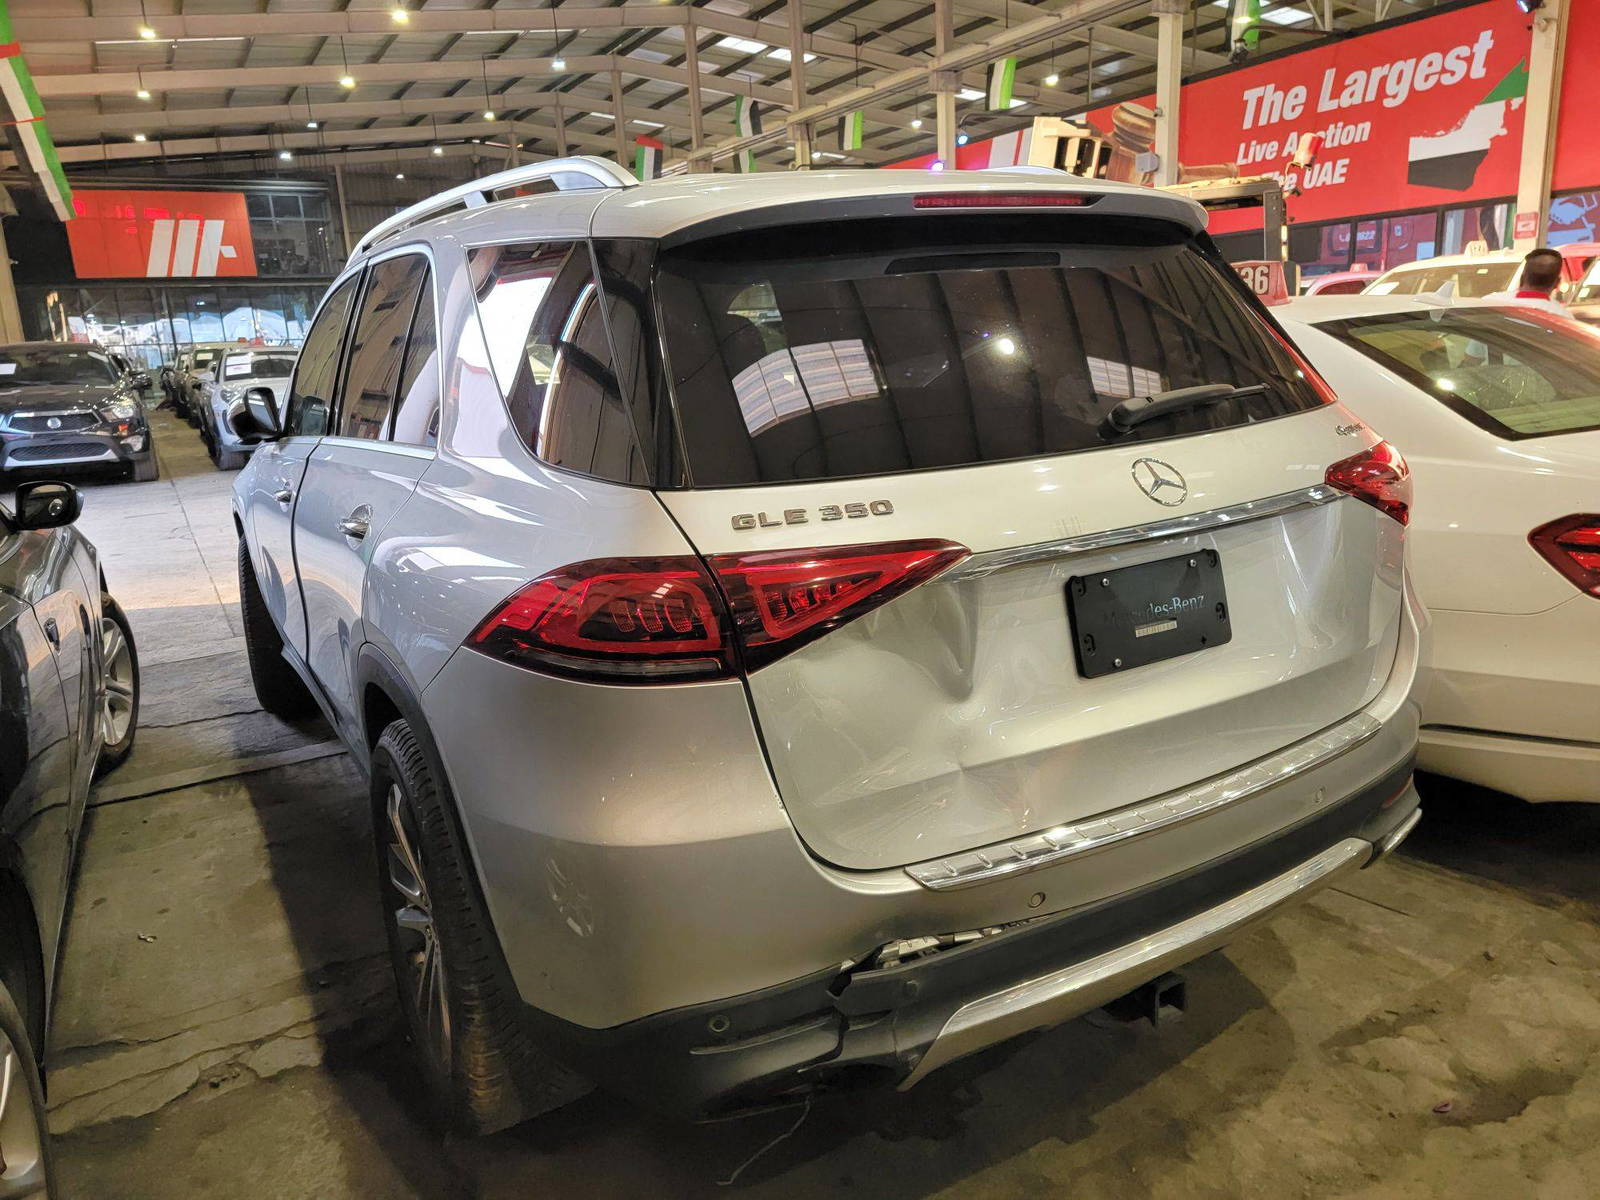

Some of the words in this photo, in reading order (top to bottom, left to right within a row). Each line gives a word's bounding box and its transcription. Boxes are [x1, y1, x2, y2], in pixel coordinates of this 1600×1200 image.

[1242, 84, 1306, 129] The
[1316, 30, 1494, 112] Largest
[1236, 140, 1279, 166] Live
[1282, 121, 1371, 157] Ation
[1303, 158, 1350, 189] UAE
[731, 508, 809, 530] GLE
[818, 499, 894, 521] 350
